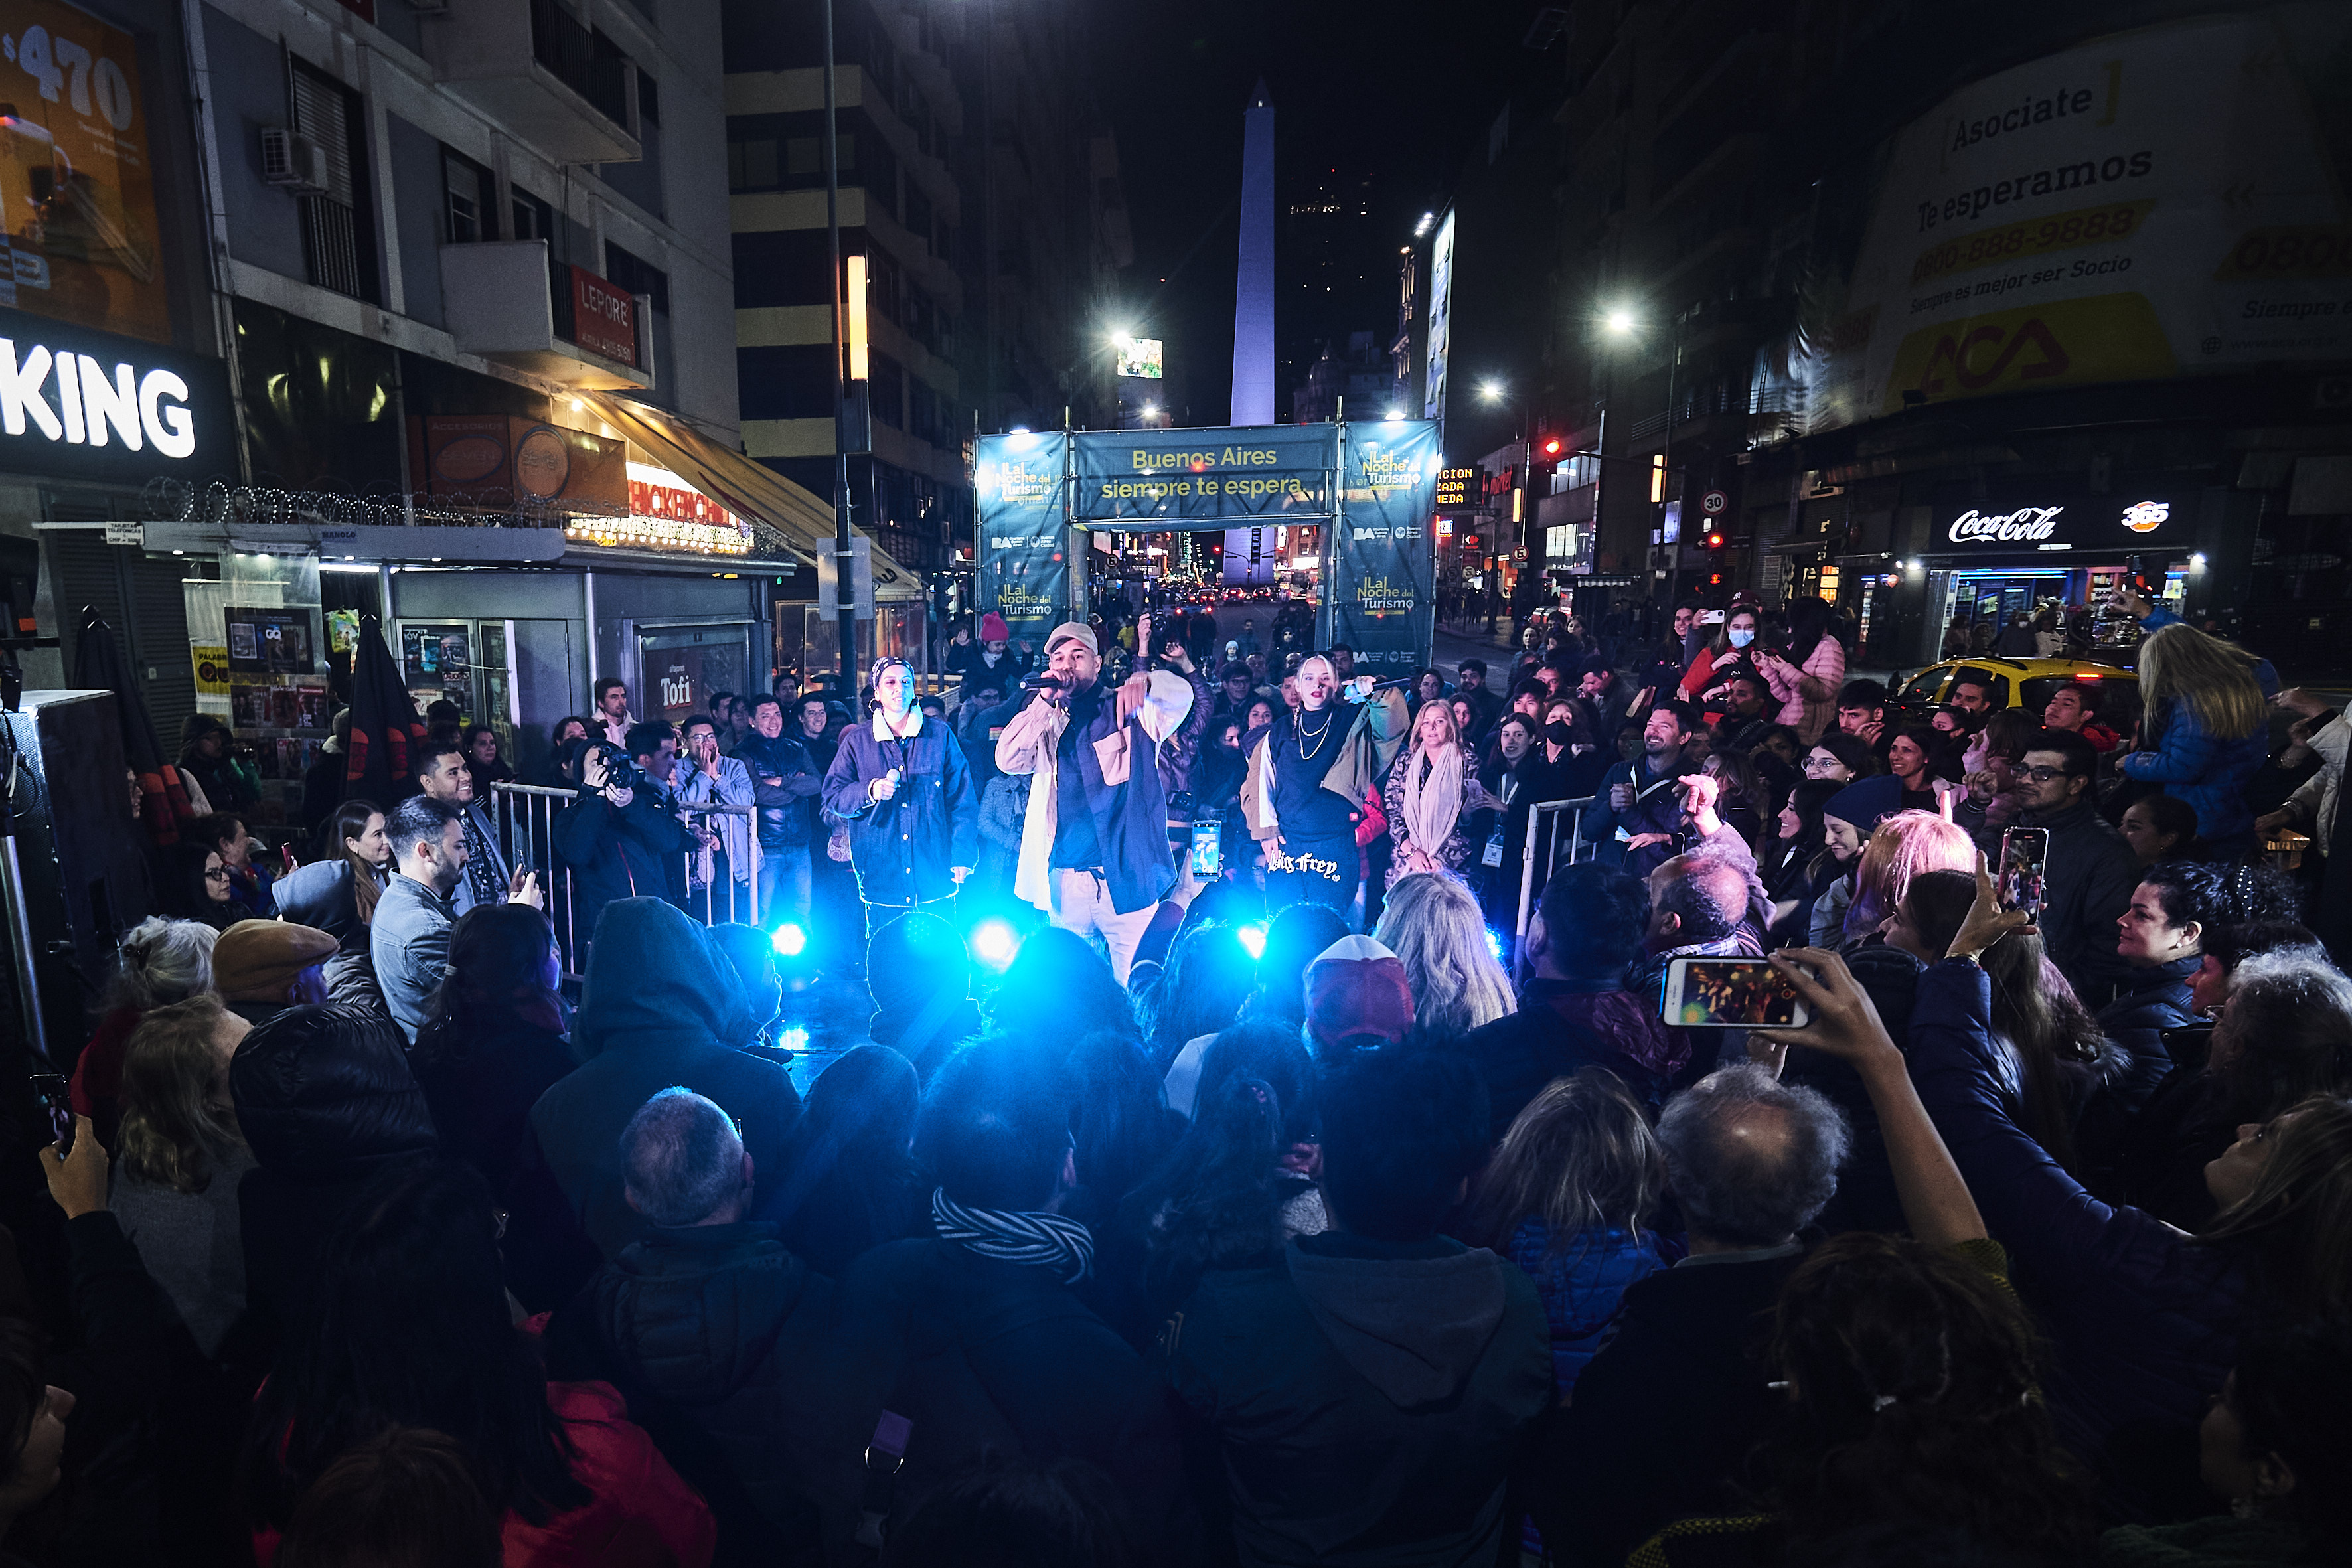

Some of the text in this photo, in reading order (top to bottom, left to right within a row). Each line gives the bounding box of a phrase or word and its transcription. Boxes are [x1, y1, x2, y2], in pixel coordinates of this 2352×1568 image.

[1919, 151, 2152, 232] Te esperamos
[1913, 208, 2134, 281] 0800-888-9888
[1911, 254, 2132, 315] Siempre es mejor ser Socio
[581, 281, 628, 327] LEPORE
[2242, 299, 2337, 320] Siempre
[0, 337, 196, 458] KING
[1133, 447, 1277, 469] Buenos Aires
[1362, 450, 1406, 475] Noche
[1372, 450, 1389, 463] La
[996, 462, 1050, 487] Noche del
[1367, 472, 1421, 484] Turismo
[1001, 483, 1051, 495] Turismo
[1101, 477, 1308, 502] siempre te espera.
[1707, 497, 1722, 509] 30
[2122, 502, 2169, 526] 365
[1354, 527, 1375, 540] BA
[1948, 506, 2064, 542] Coca-Cola
[992, 536, 1012, 549] BA
[1008, 584, 1022, 595] La
[1357, 576, 1414, 601] Noche del
[1368, 576, 1383, 589] La
[998, 584, 1051, 607] Noche del
[1362, 597, 1415, 609] Turismo
[1002, 604, 1052, 615] Turismo
[660, 674, 691, 706] Tofi
[1294, 852, 1338, 879] Frey
